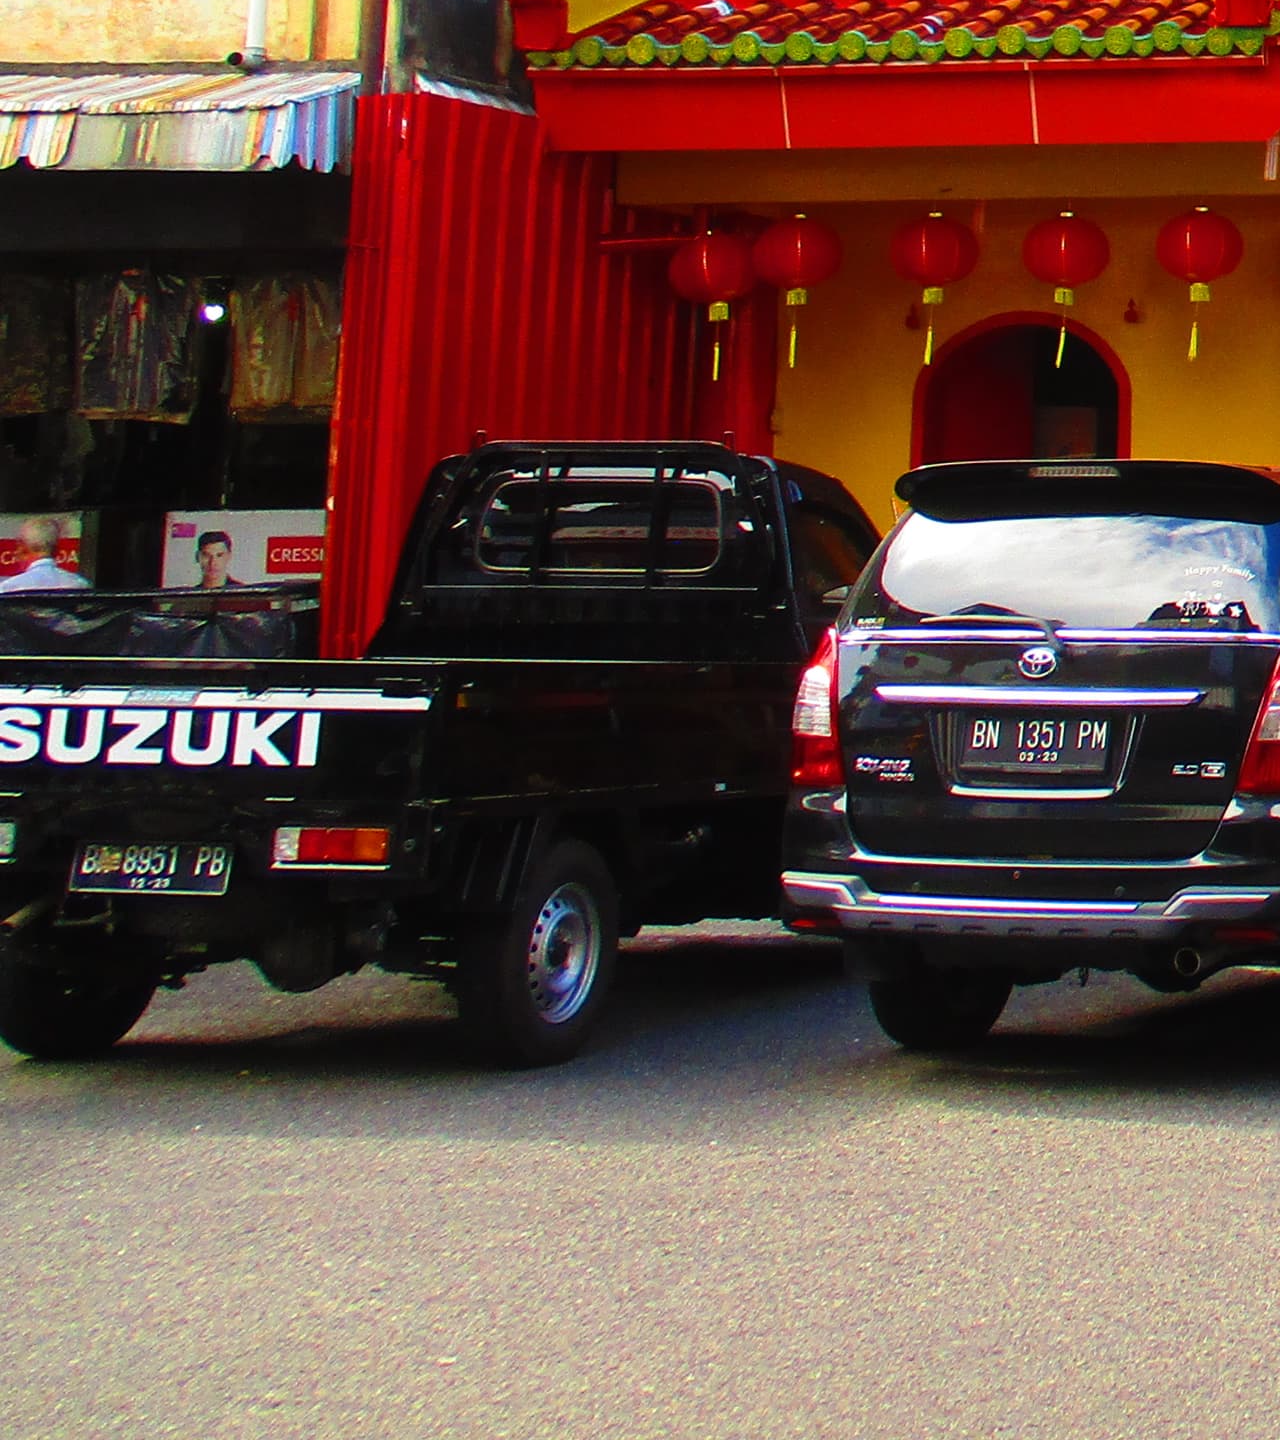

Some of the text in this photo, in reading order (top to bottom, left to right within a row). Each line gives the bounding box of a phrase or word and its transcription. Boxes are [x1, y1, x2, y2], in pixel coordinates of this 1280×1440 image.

[1184, 564, 1256, 581] Happy Family
[0, 706, 321, 766] SUZUKI
[972, 720, 1108, 749] BN 1351 PM
[122, 845, 180, 875] 8951
[194, 846, 226, 876] PB
